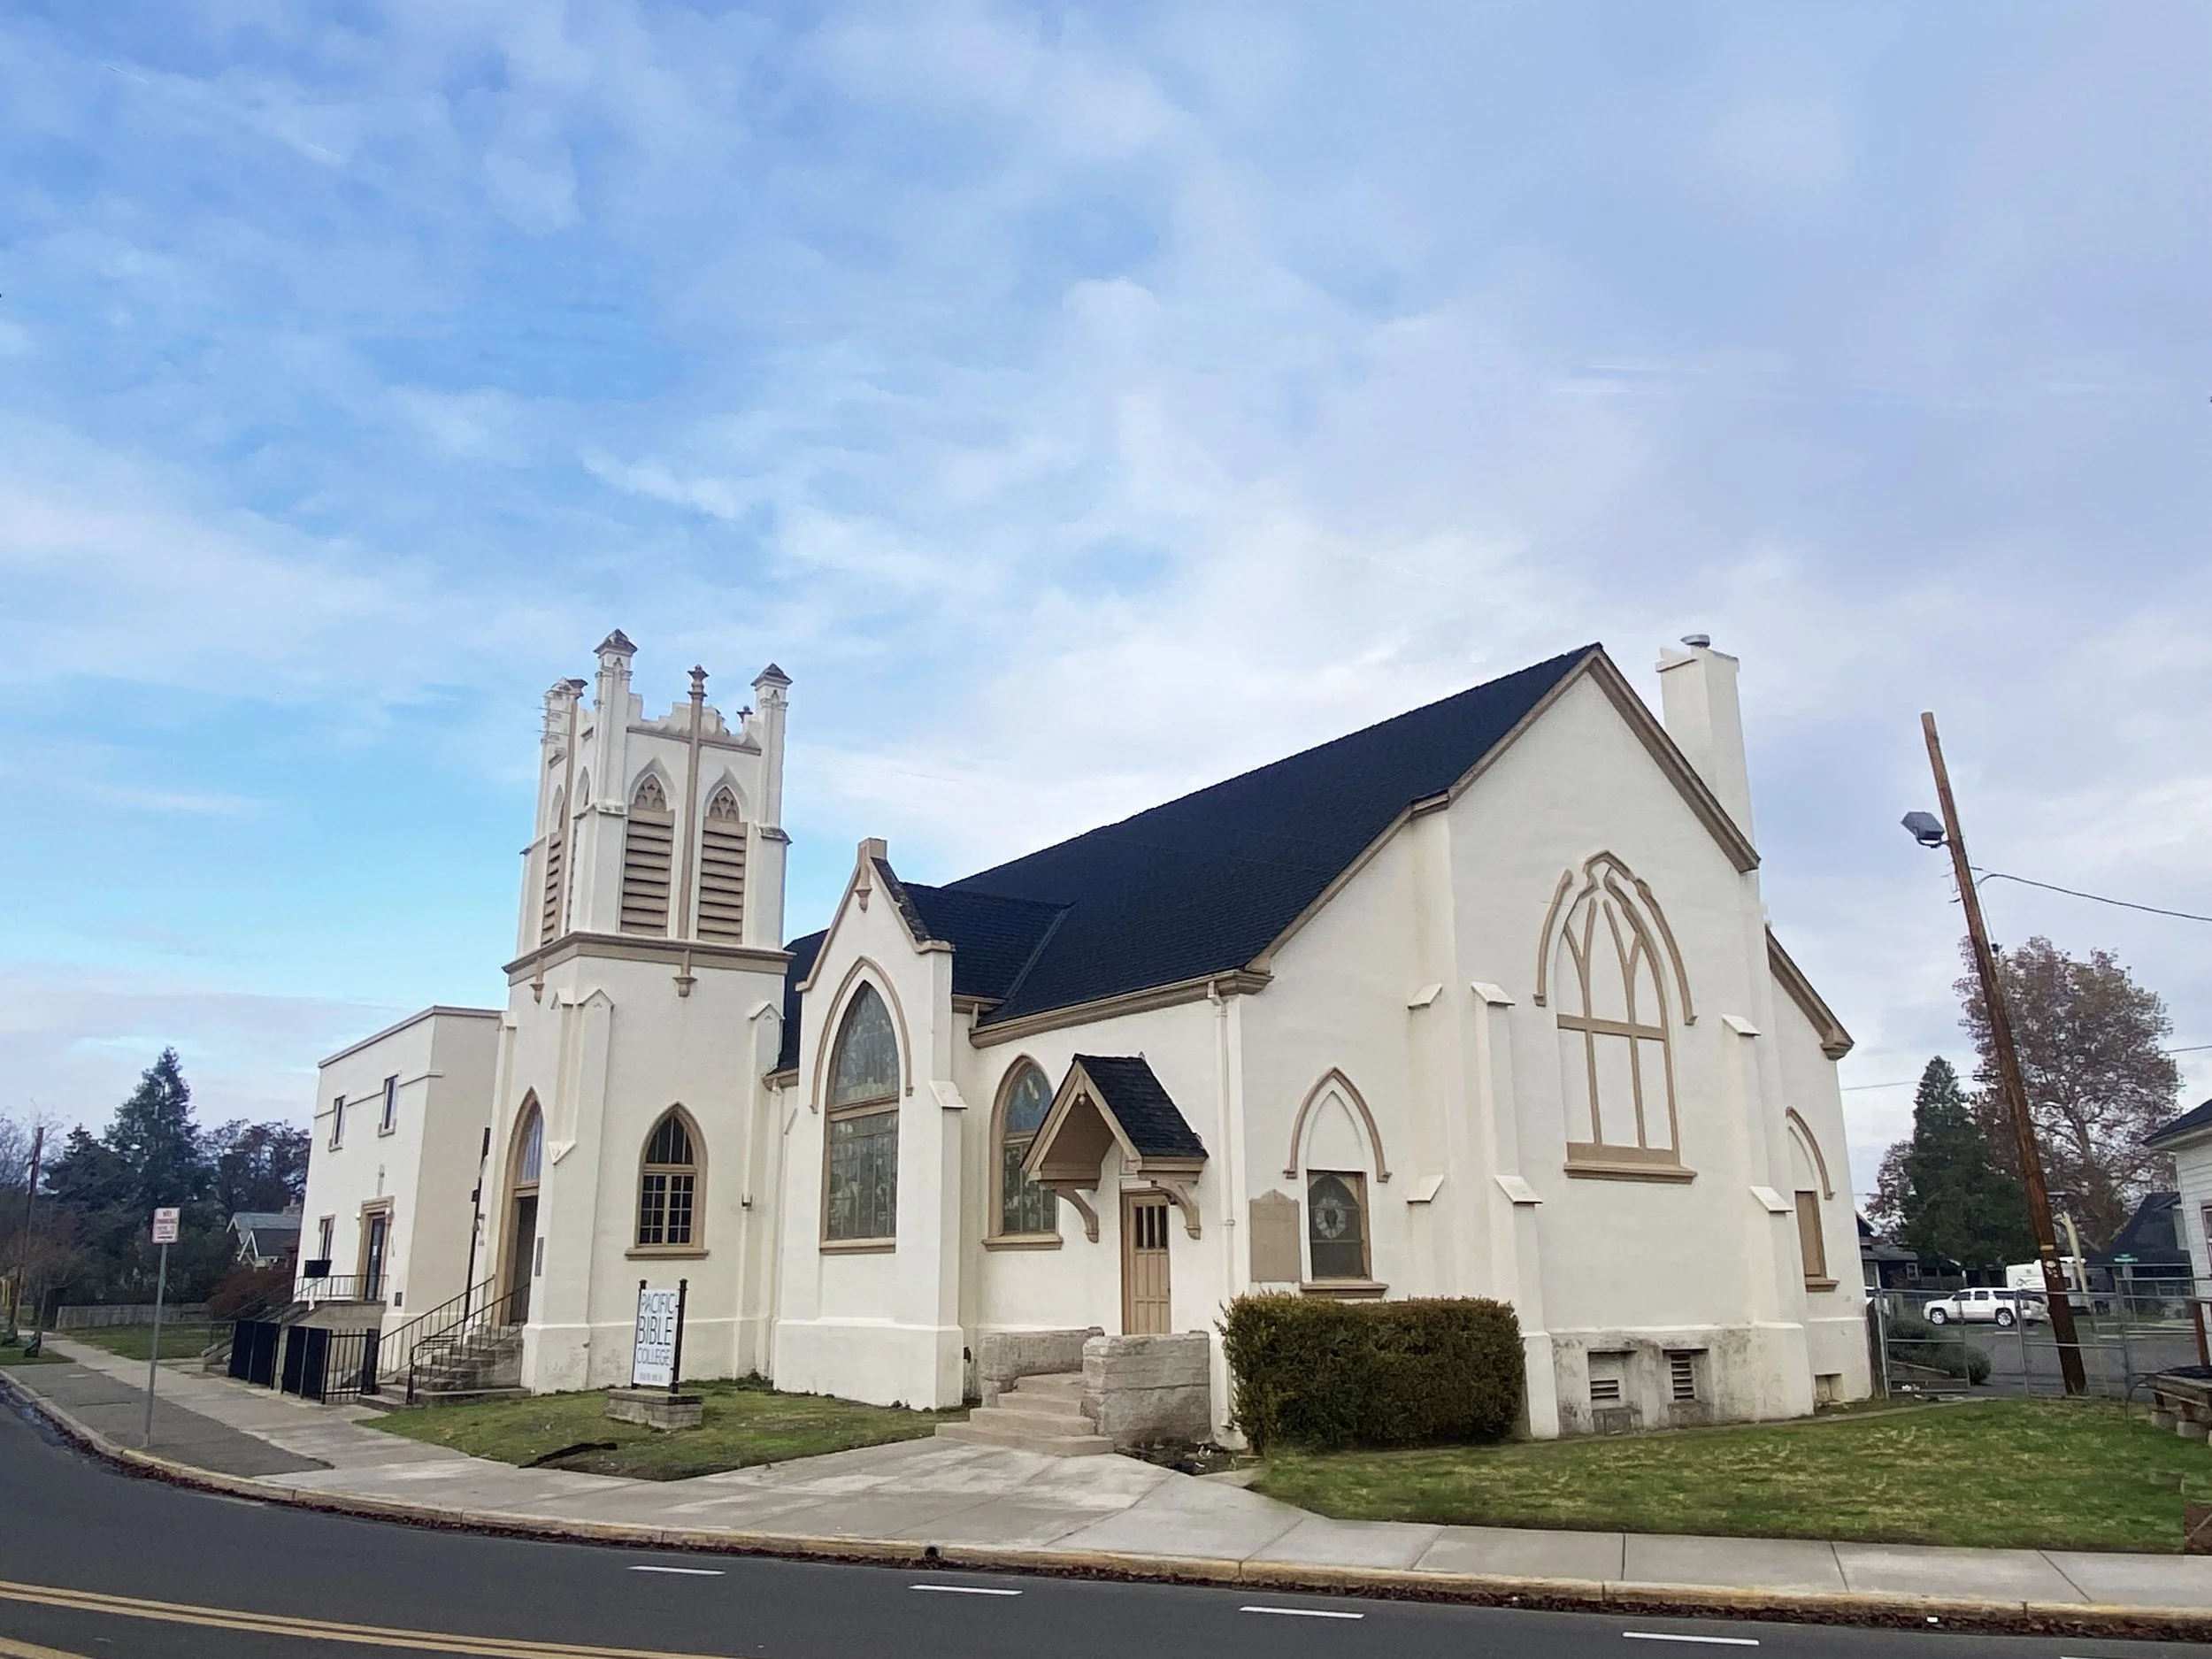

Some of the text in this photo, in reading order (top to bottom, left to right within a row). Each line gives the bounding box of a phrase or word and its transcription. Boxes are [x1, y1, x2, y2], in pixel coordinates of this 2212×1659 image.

[641, 1293, 675, 1314] PACIFIC
[638, 1316, 673, 1345] BIBLE
[637, 1348, 671, 1366] COLLEGE
